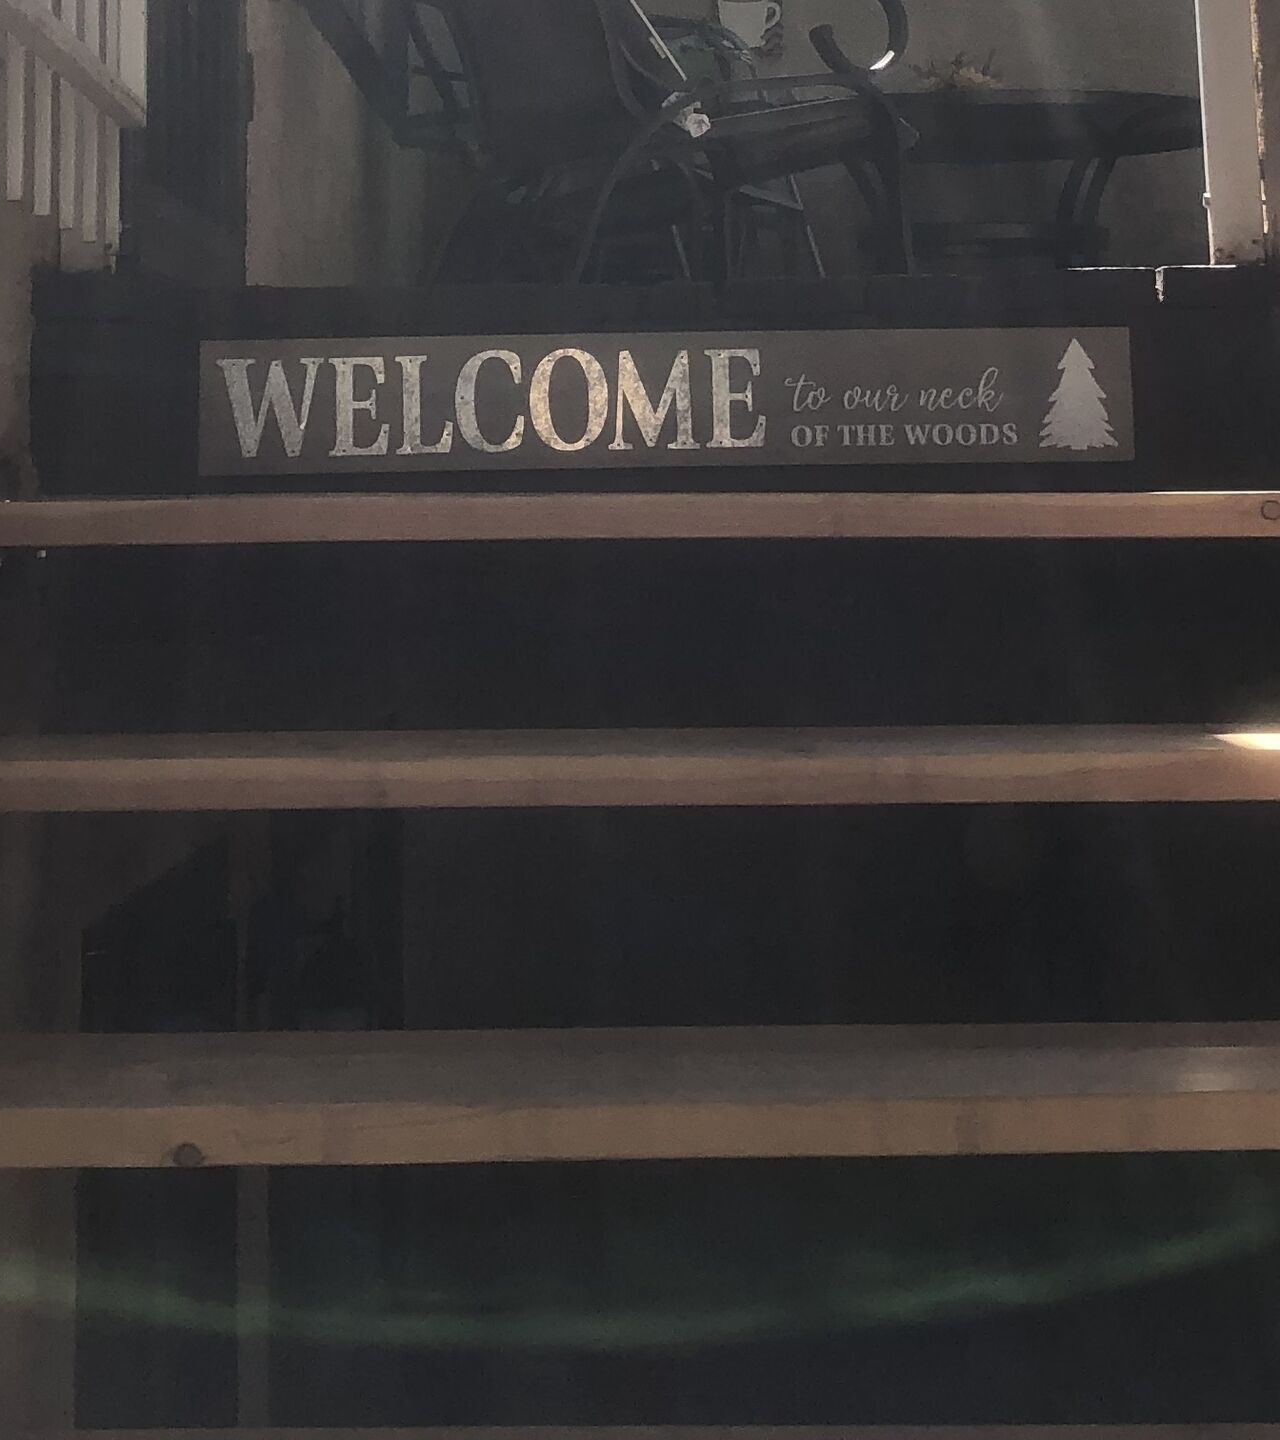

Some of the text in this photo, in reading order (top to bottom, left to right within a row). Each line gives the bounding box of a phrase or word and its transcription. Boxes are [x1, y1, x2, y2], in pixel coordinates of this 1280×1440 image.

[215, 347, 767, 459] WELCOME
[784, 366, 1005, 412] to our neck
[790, 422, 1020, 448] OF THE WOODS
